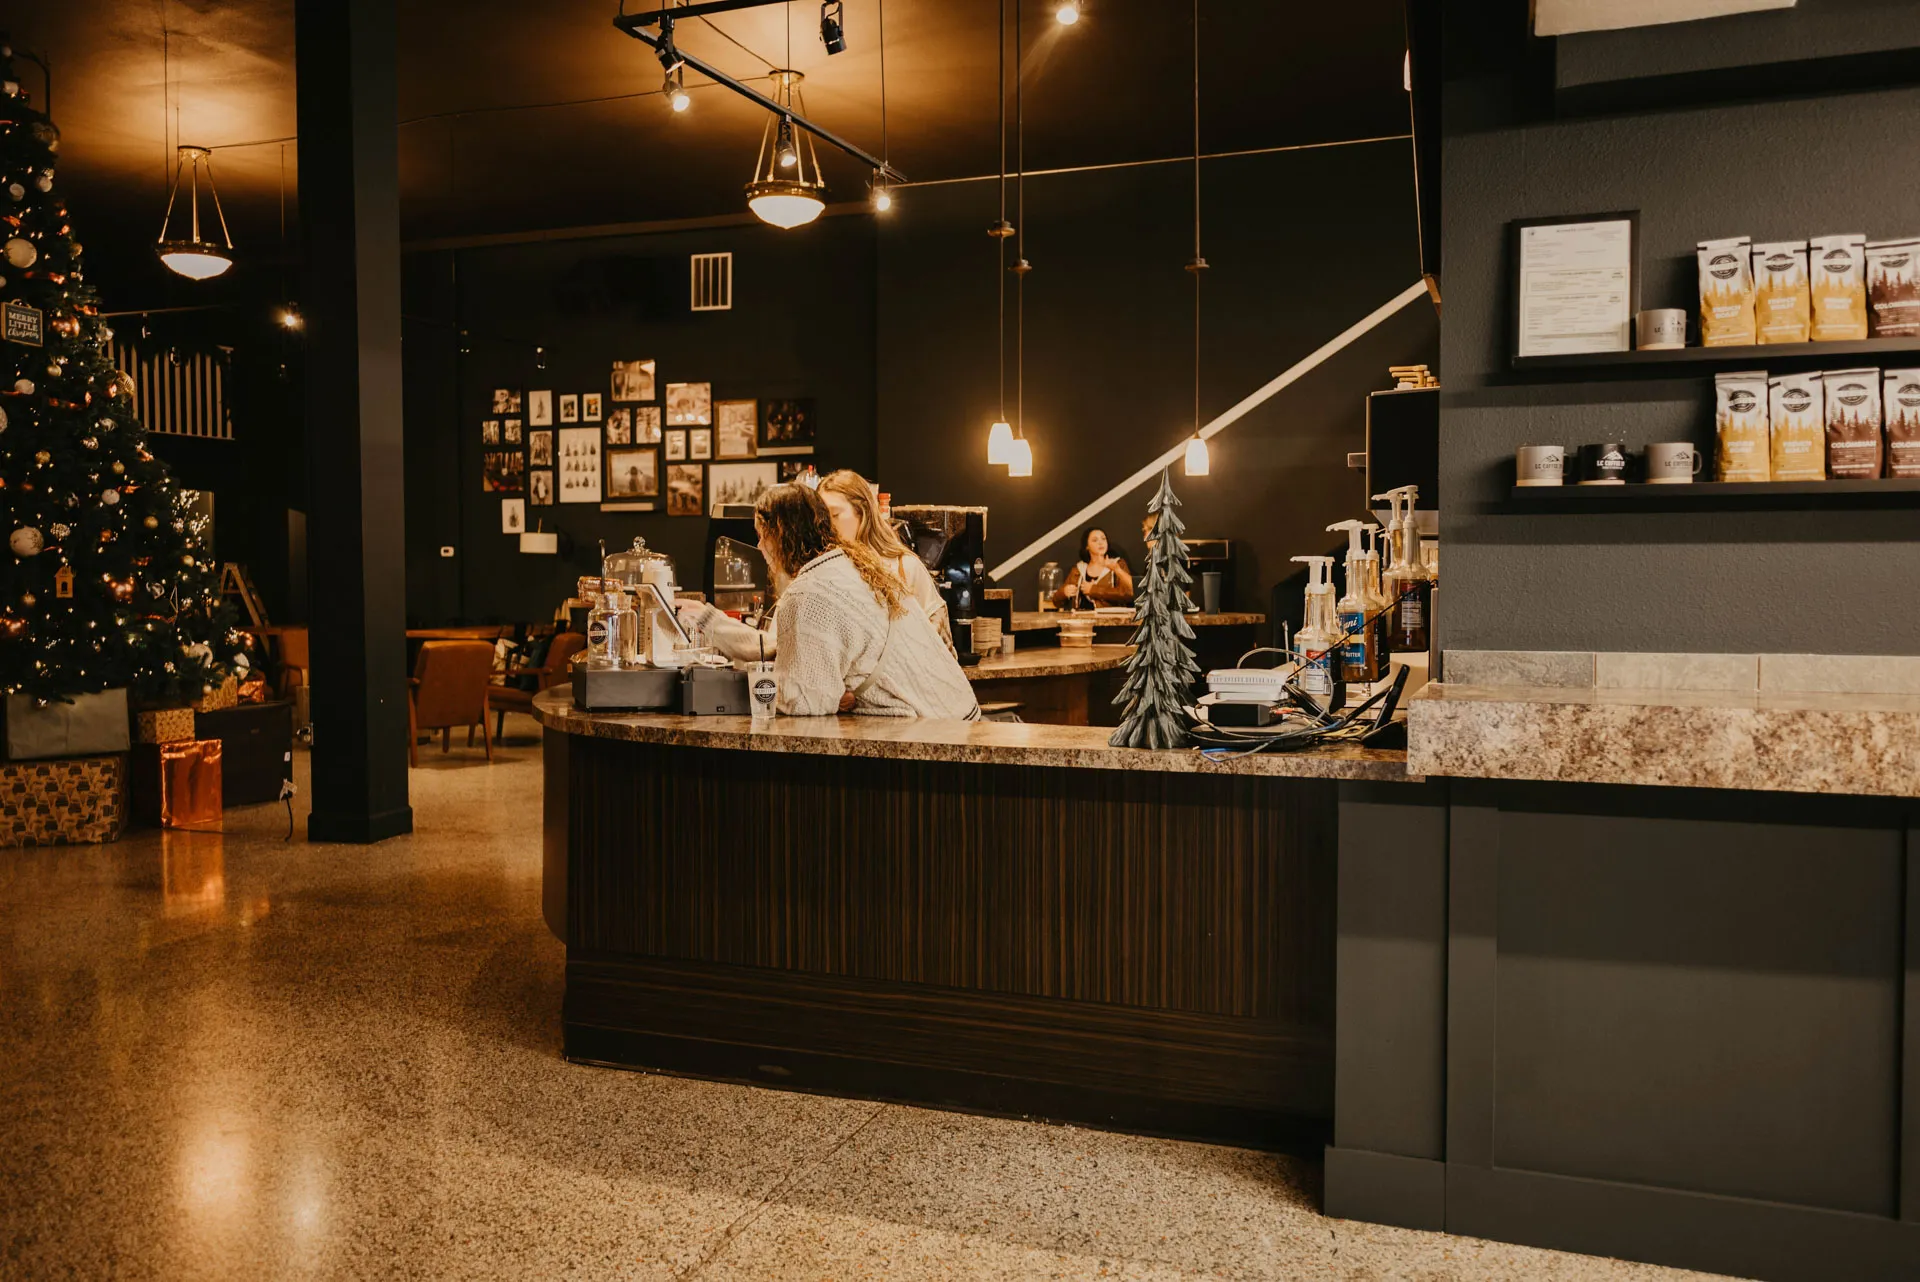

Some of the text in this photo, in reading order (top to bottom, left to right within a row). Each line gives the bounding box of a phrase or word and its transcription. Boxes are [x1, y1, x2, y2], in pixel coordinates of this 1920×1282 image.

[8, 311, 38, 324] MERRY
[9, 319, 38, 332] LITTLE
[1831, 440, 1877, 449] COLOMBIAN
